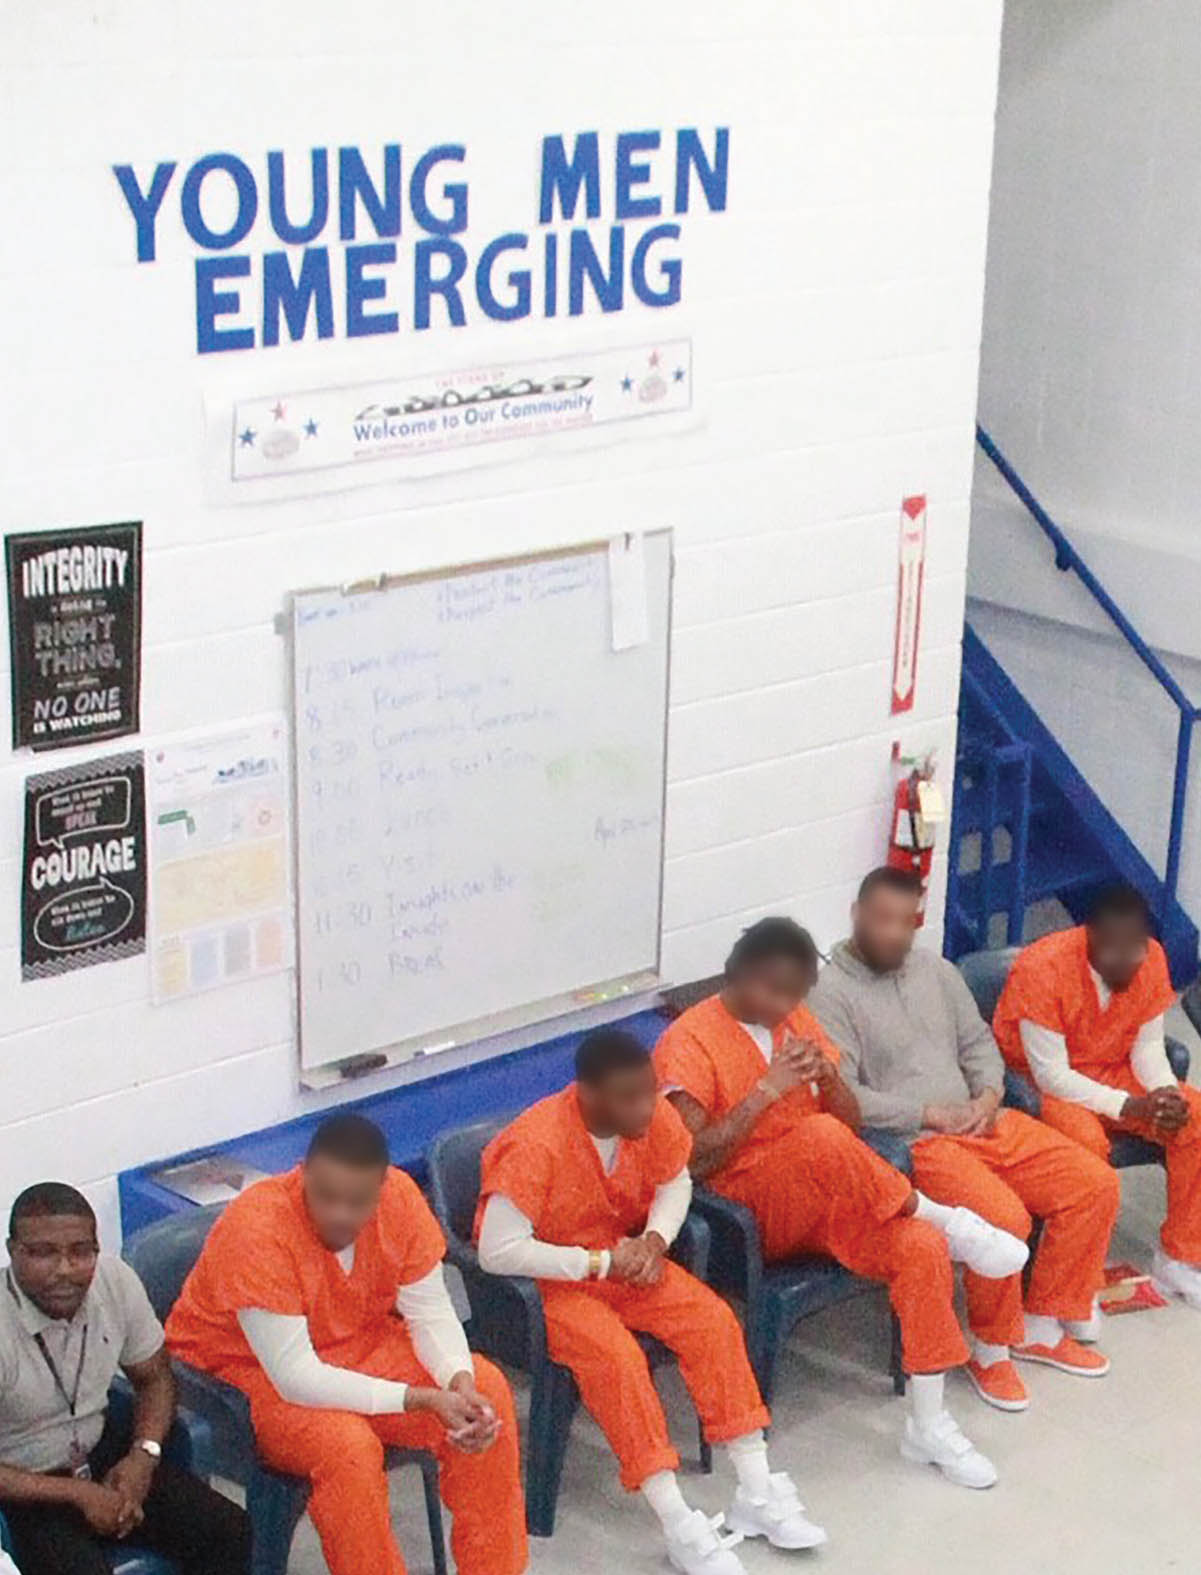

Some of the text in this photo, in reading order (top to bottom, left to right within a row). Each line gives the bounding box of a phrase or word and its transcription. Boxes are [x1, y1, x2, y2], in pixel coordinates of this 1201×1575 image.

[112, 126, 730, 262] YOUNG MEN
[195, 223, 682, 355] EMERGING
[353, 417, 437, 442] Welcome
[442, 414, 459, 430] to
[464, 407, 497, 426] Our
[500, 393, 594, 421] Community
[22, 545, 128, 598] INTEGRITY
[34, 613, 116, 650] RIGHT
[34, 686, 121, 719] NO ONE
[49, 709, 122, 732] WATCHING
[31, 836, 137, 890] COURAGE
